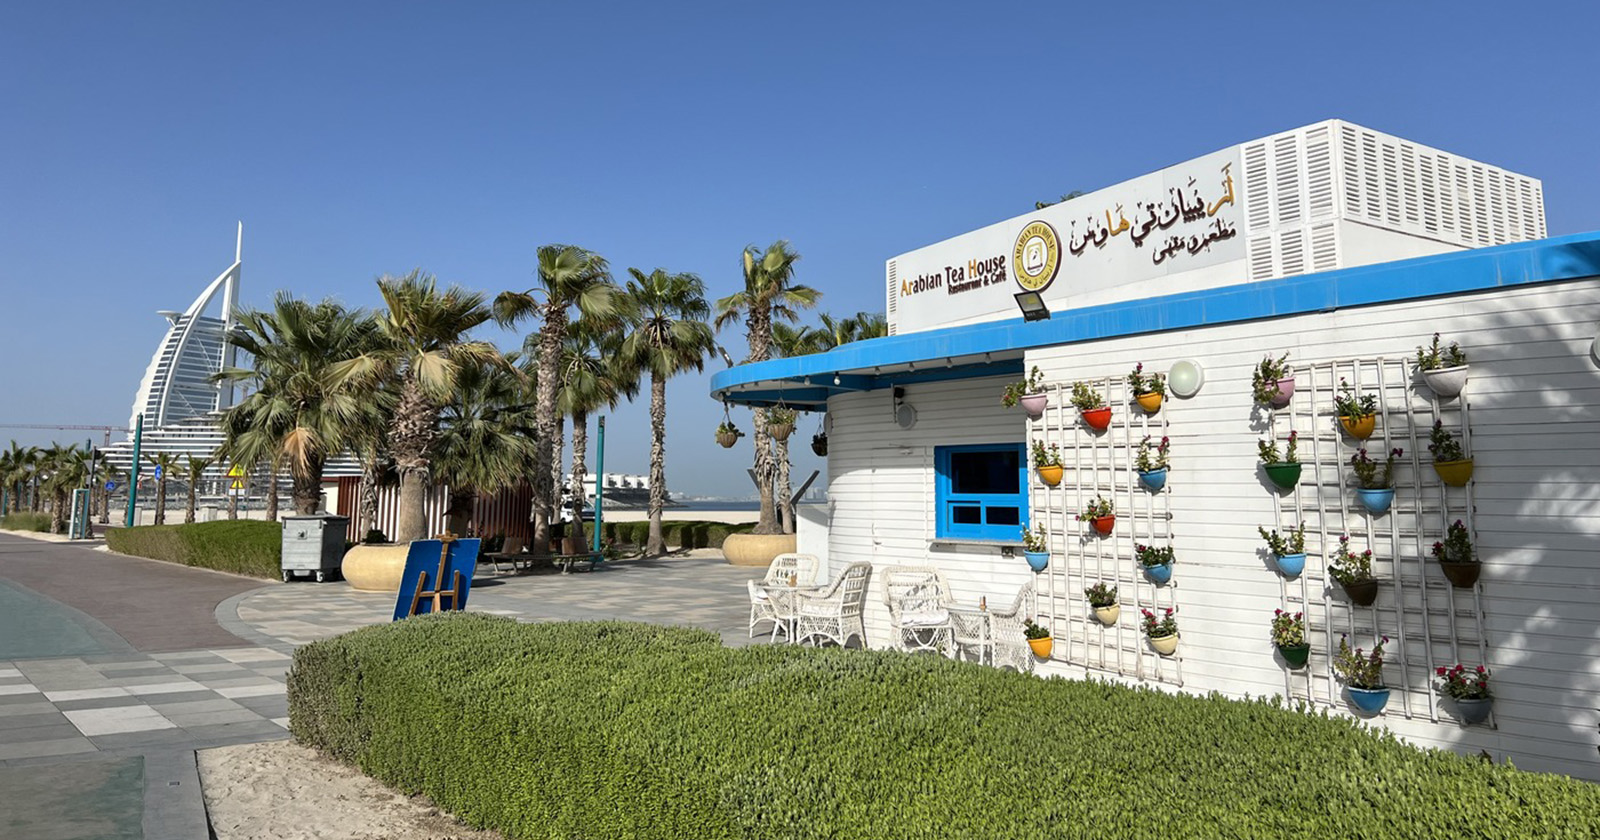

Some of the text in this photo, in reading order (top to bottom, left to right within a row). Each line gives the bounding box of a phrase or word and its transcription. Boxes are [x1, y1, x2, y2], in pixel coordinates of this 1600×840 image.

[1069, 202, 1130, 257] هاوس
[1131, 201, 1158, 248] تي
[900, 255, 1006, 297] Arabian Tea House
[990, 269, 1007, 285] Café
